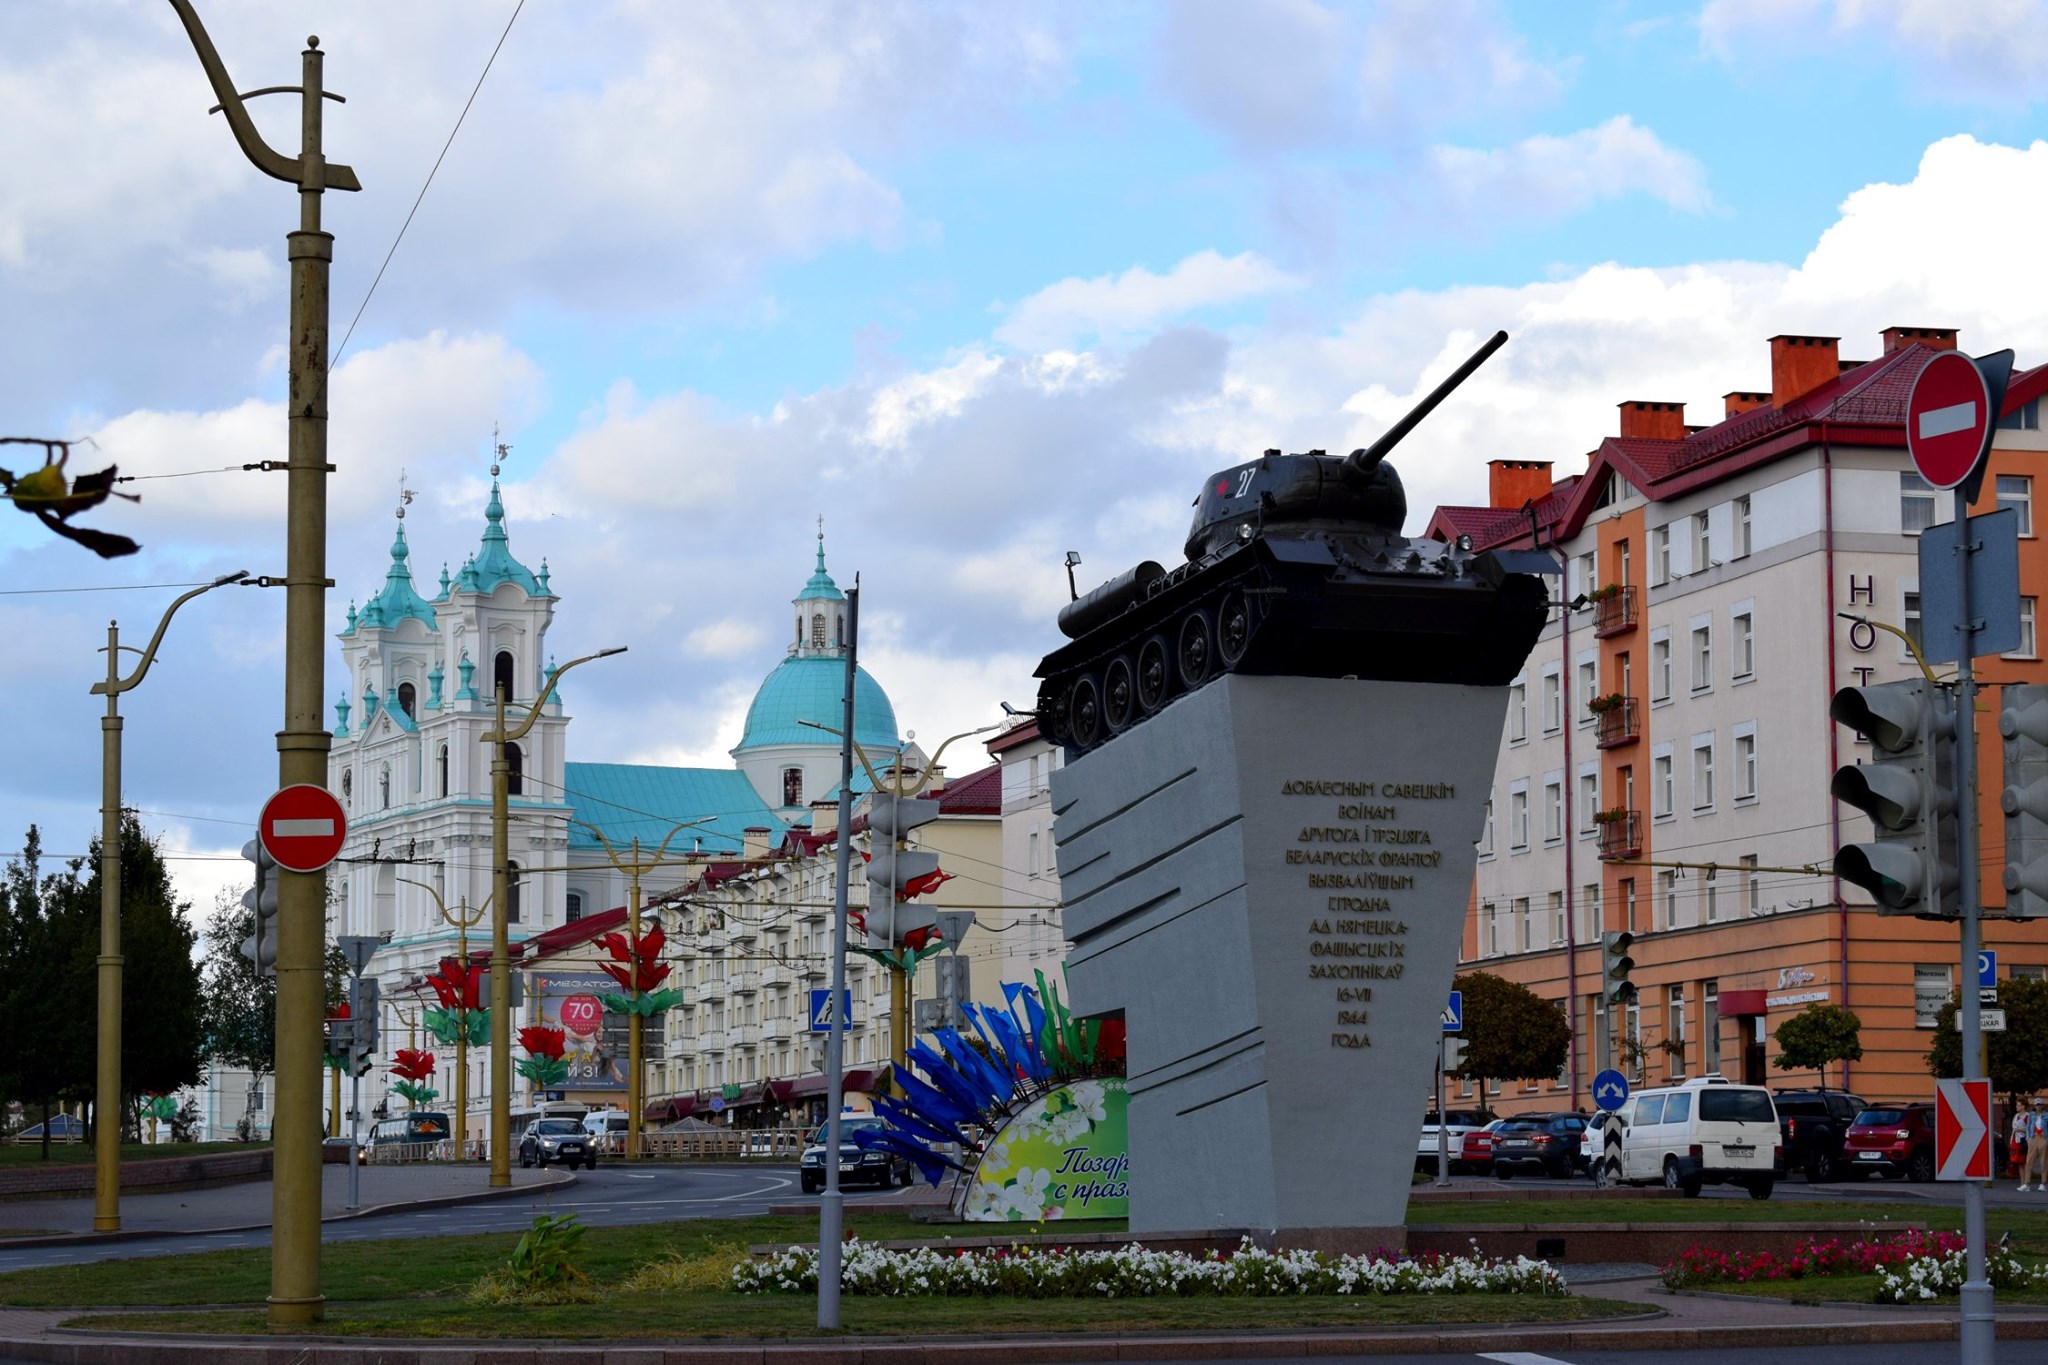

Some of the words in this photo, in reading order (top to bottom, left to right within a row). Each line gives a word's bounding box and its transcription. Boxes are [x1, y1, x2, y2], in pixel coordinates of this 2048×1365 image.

[1235, 467, 1257, 499] 27
[1281, 779, 1375, 798] ДОБЛЕСНЫМ
[1382, 781, 1456, 801] САВЕЦКІМ
[1297, 826, 1360, 844] ДРУГОГА
[1372, 828, 1432, 845] ТРЭЦЯГА
[1286, 848, 1375, 867] БЕЛАРУСКІХ
[1379, 849, 1443, 868] ФРАНТОЎ
[1308, 918, 1332, 934] АД
[1310, 940, 1406, 958] ФАШЫСЦКІХ
[1308, 962, 1405, 980] ЗАХОПНІКАЎ
[1338, 1010, 1369, 1026] 1944
[1331, 1032, 1372, 1049] ГОДА
[1054, 1183, 1068, 1200] с
[1071, 1179, 1129, 1207] праз
